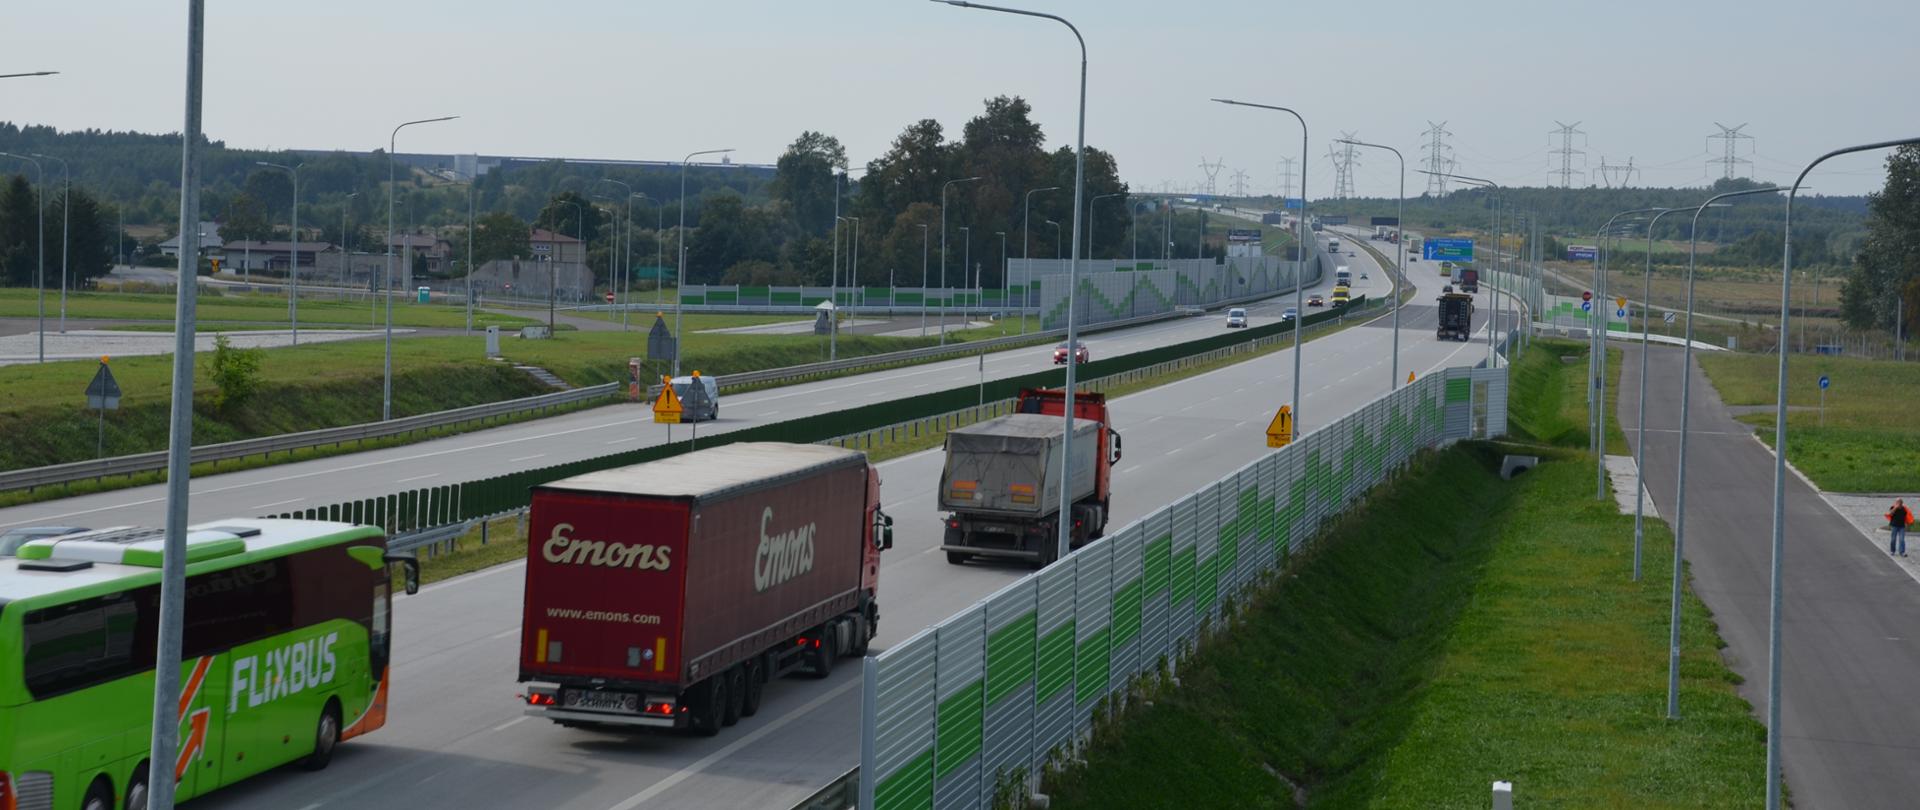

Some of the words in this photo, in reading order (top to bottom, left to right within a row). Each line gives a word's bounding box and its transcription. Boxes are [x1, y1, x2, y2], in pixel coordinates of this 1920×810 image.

[543, 523, 671, 570] Emons
[755, 506, 816, 592] Emons
[547, 607, 660, 624] www.emons.com
